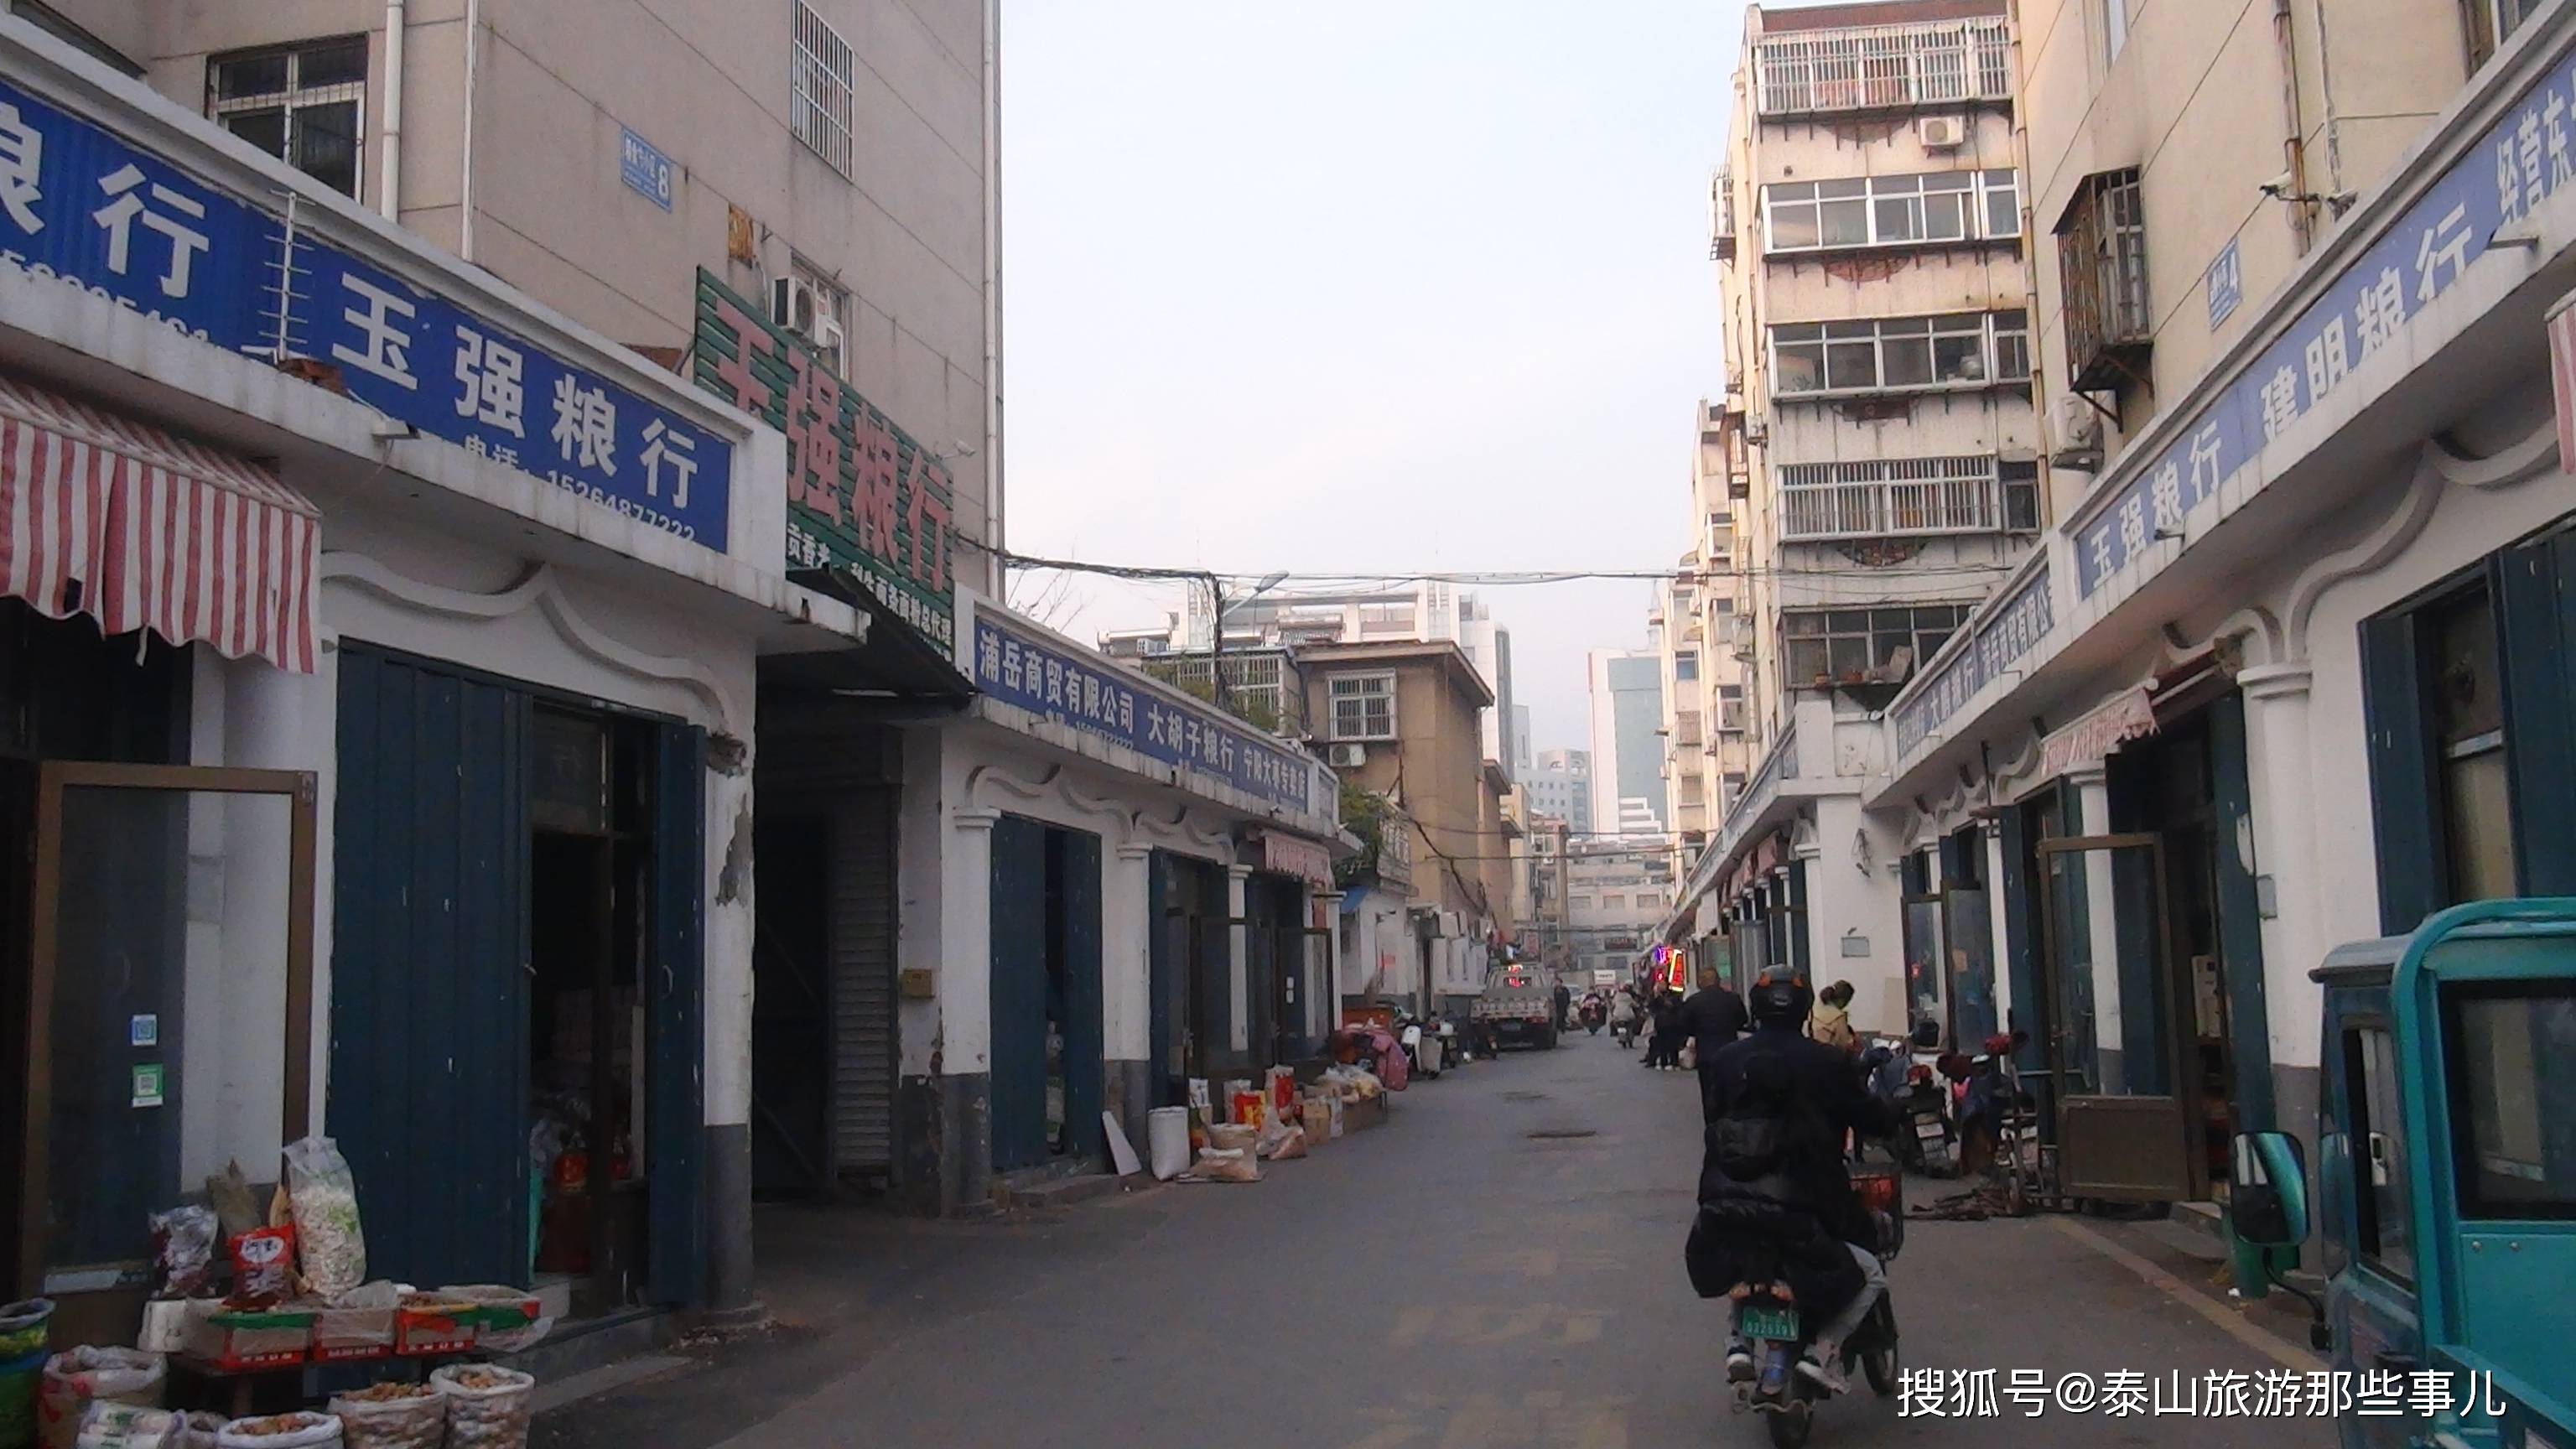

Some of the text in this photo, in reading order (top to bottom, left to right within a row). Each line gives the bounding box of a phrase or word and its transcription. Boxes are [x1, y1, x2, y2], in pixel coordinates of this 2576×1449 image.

[2496, 68, 2576, 224] 经营东
[332, 272, 698, 510] 玉强粮行
[2260, 201, 2473, 444] 建明粮行
[2090, 420, 2222, 589] 玉强粮行
[1147, 703, 1235, 773] 大胡子粮行
